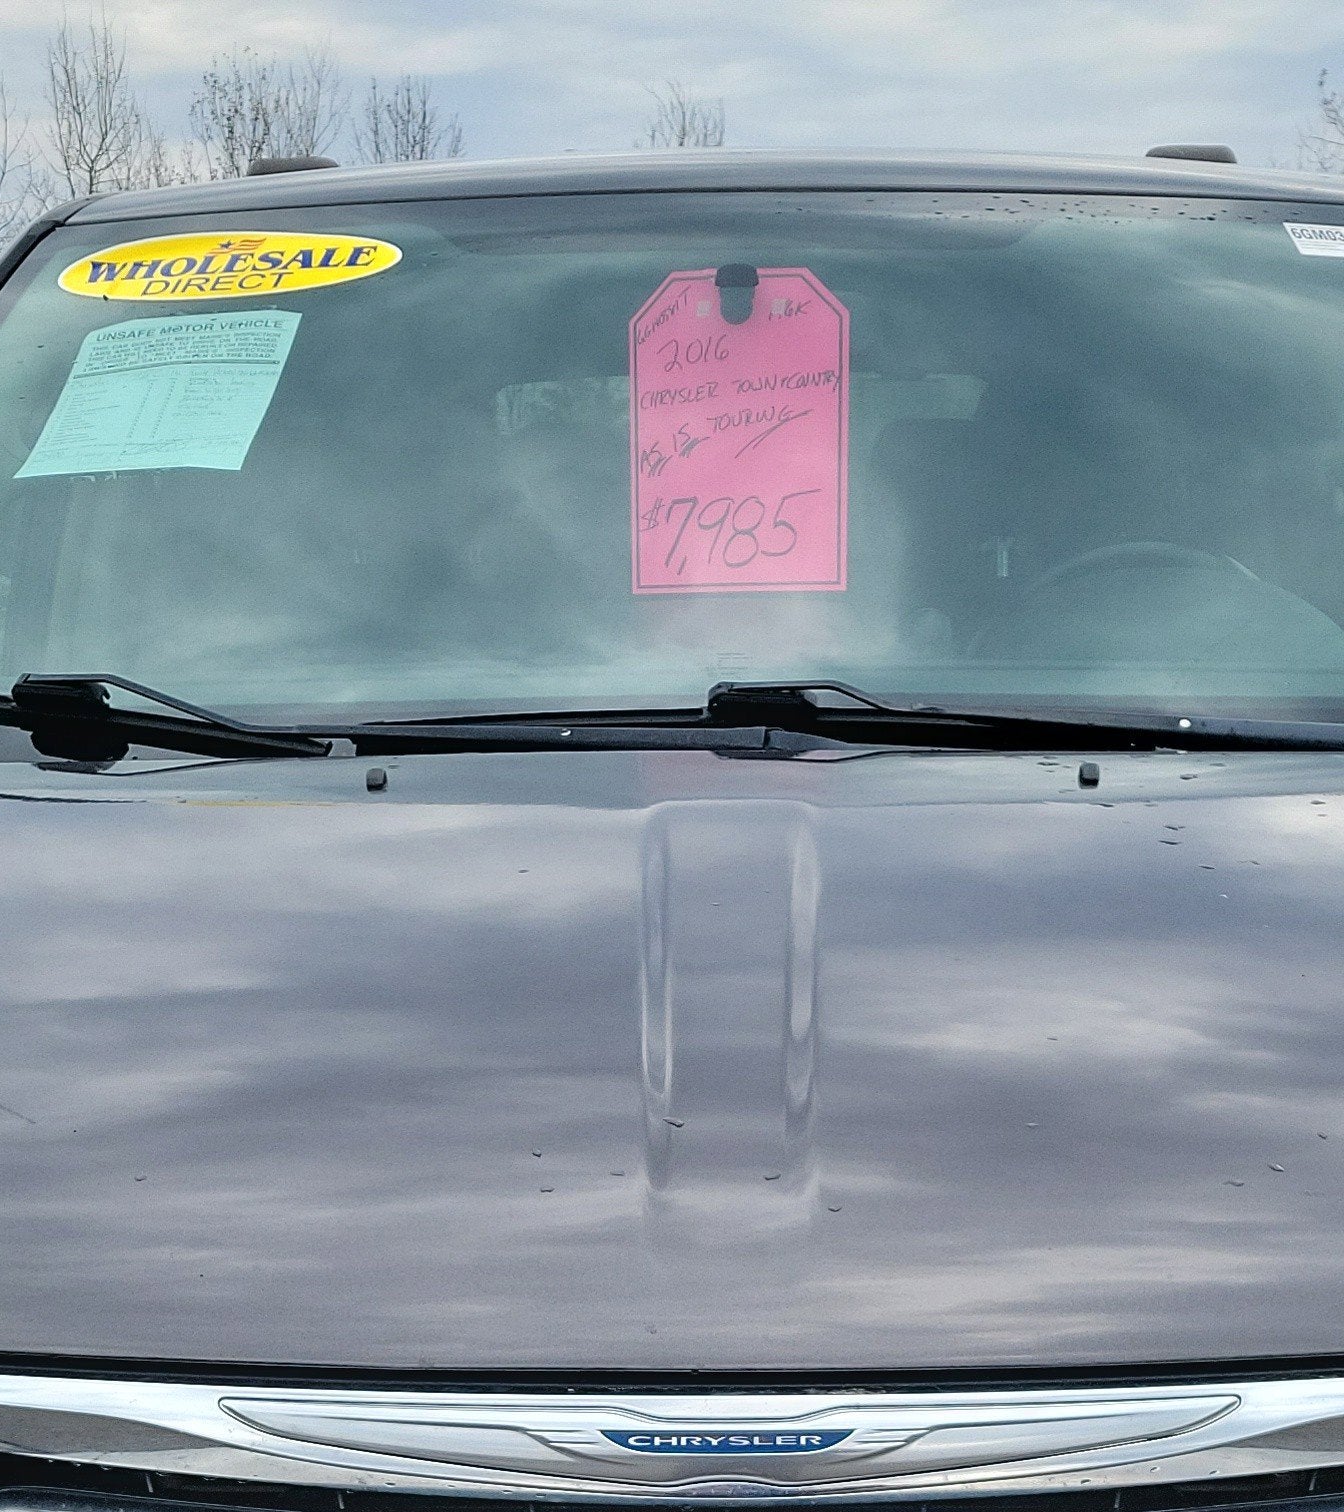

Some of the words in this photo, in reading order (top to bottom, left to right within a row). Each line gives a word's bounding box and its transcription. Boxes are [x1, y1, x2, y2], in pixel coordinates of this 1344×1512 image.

[85, 245, 378, 284] WHOLESALE
[140, 271, 295, 297] DIRECT
[96, 329, 154, 341] UNSAFE
[160, 323, 216, 335] MOTOR
[220, 319, 285, 330] VEHICLE
[656, 334, 730, 373] 2016
[640, 382, 718, 410] CHRYSLER
[627, 1434, 822, 1447] CHRYSLER
